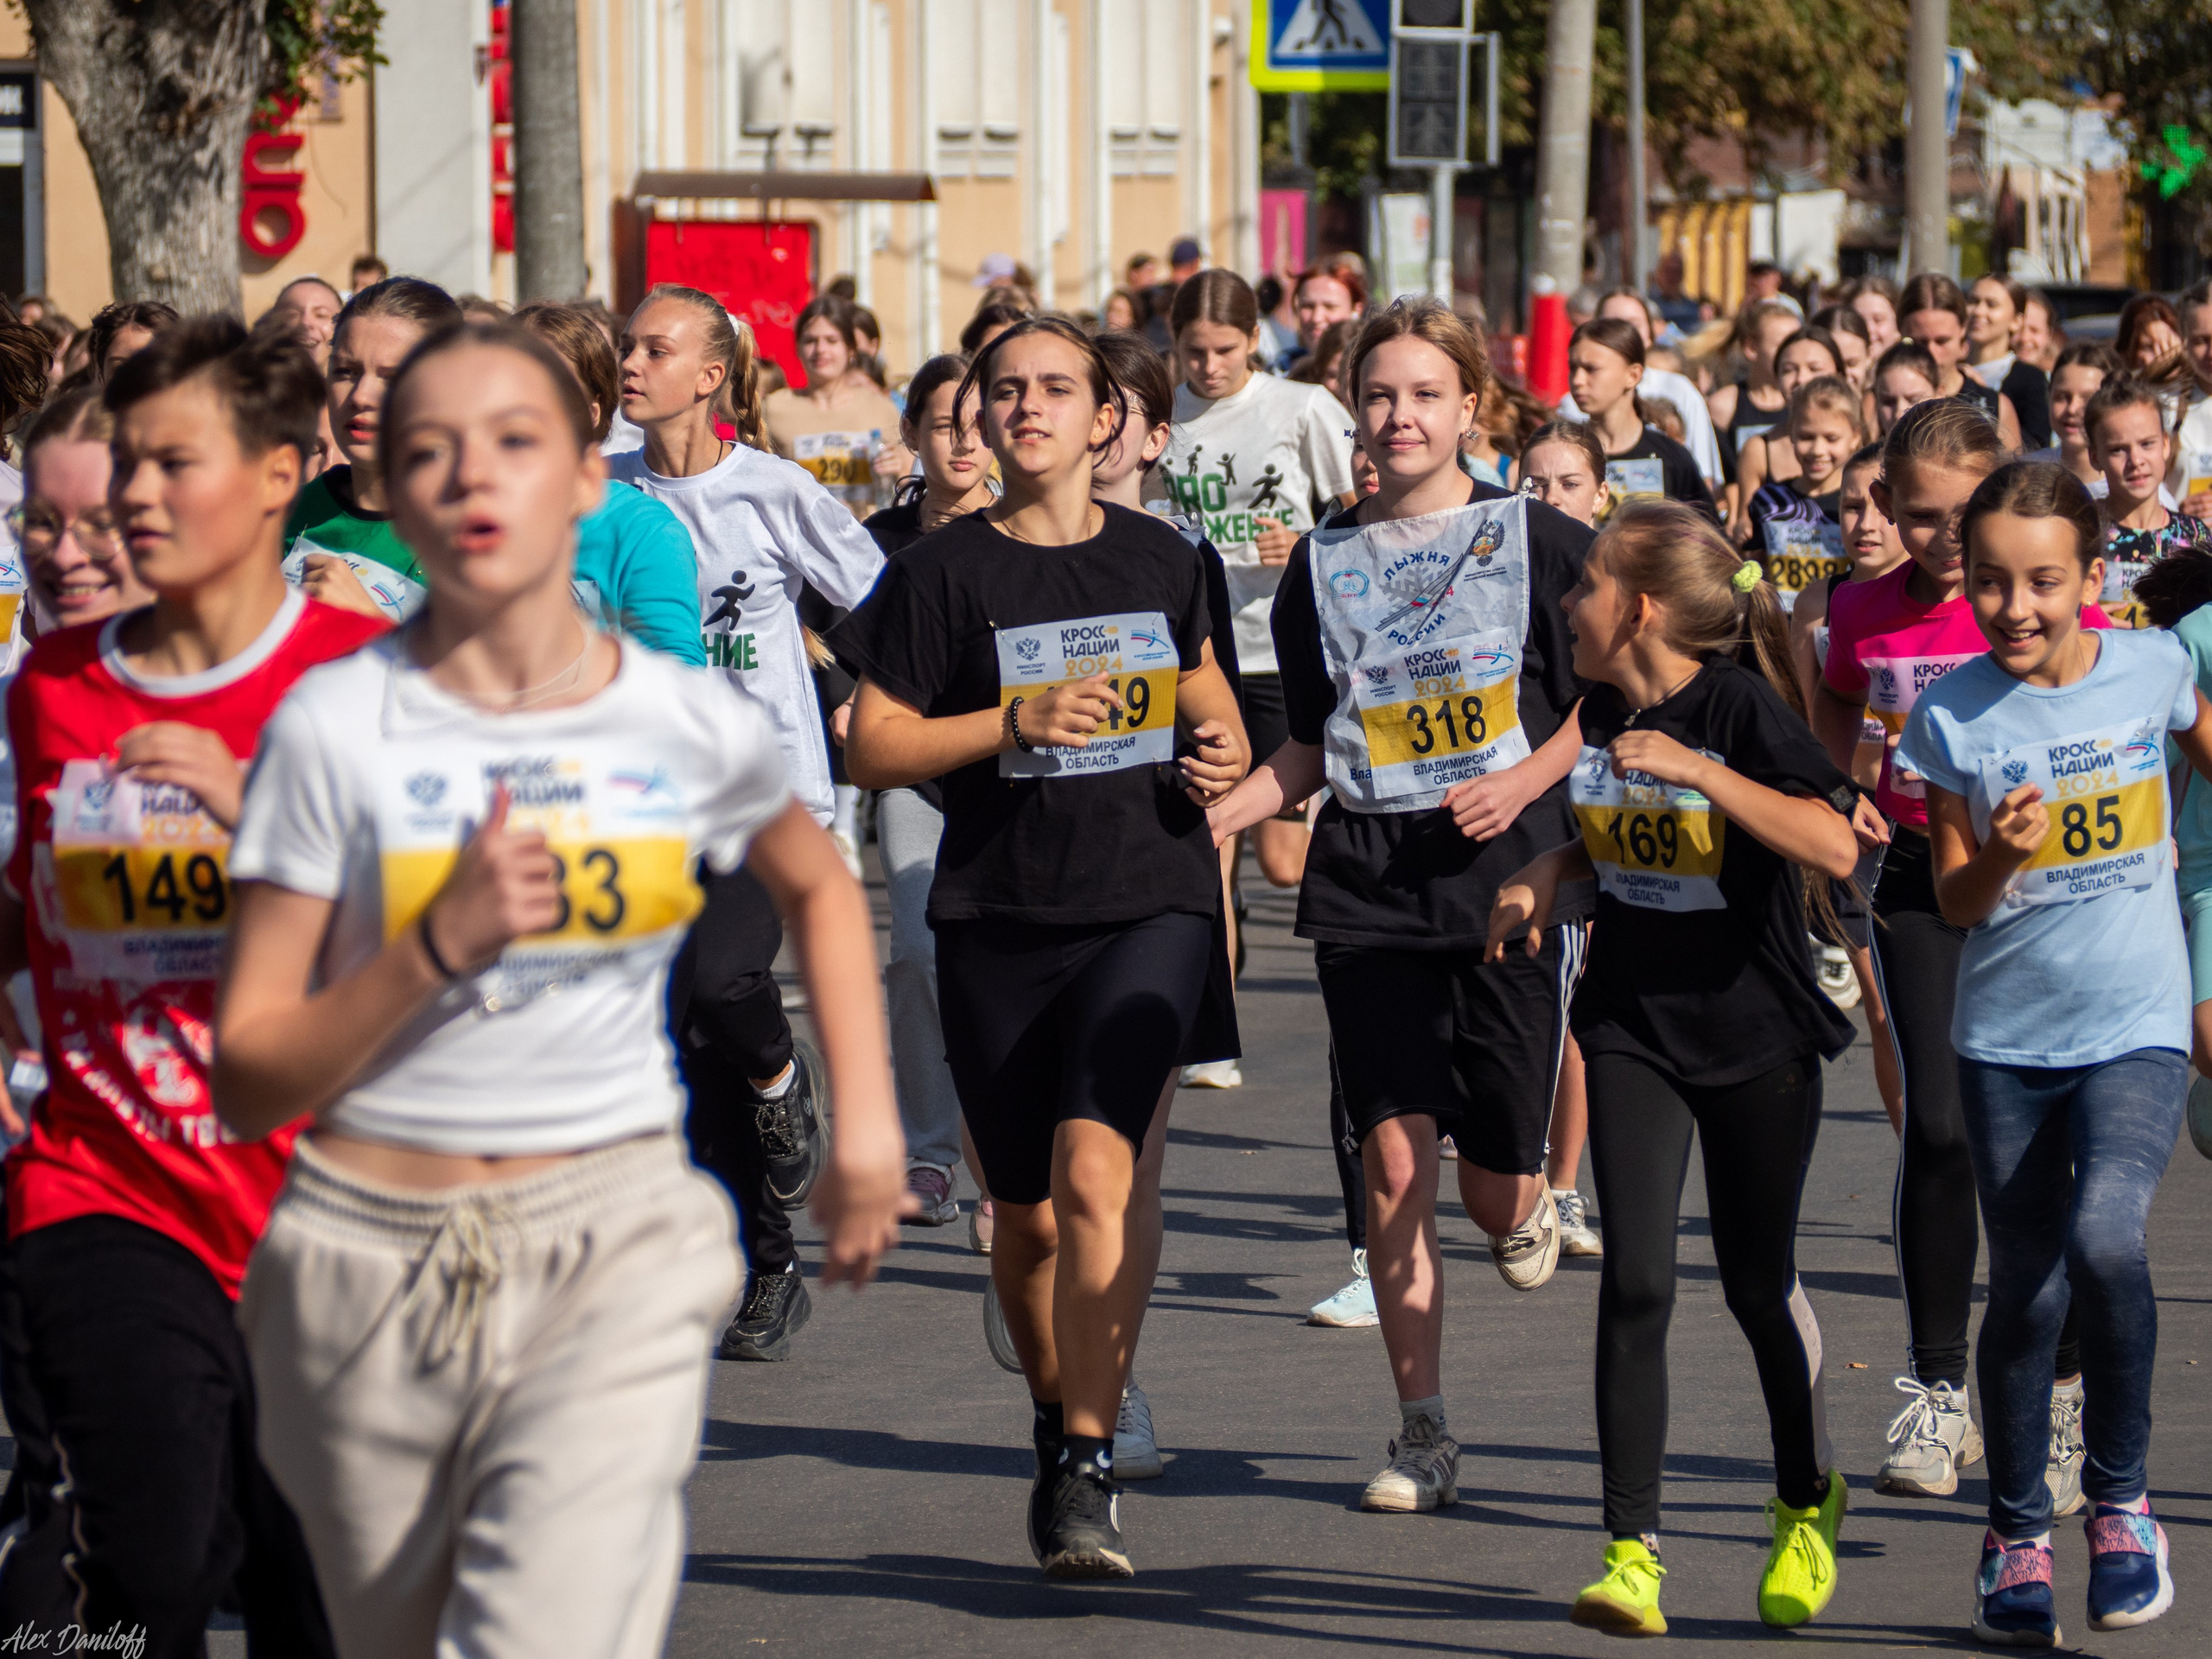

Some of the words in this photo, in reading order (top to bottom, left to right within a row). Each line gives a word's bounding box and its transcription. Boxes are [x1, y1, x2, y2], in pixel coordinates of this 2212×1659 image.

[1382, 550, 1451, 582] ЛЫЖНЯ
[1060, 625, 1106, 643] КРОСС
[1063, 639, 1121, 658] НАЦИИ
[1403, 647, 1447, 668] КРОСС
[1065, 654, 1124, 677] 2024
[1408, 659, 1462, 681] НАЦИИ
[1414, 673, 1467, 697] 2024
[1406, 695, 1486, 754] 318
[1065, 753, 1120, 770] ОБЛАСТЬ
[1413, 746, 1498, 776] ВЛАДИМИРСКАЯ
[2048, 739, 2099, 763] КРОСС
[1433, 766, 1487, 785] ОБЛАСТЬ
[2050, 752, 2114, 779] НАЦИИ
[2056, 769, 2120, 798] 2024
[2062, 794, 2124, 858] 85
[1607, 812, 1678, 869] 169
[2046, 852, 2145, 884] ВЛАДИМИРСКАЯ
[103, 851, 226, 924] 149
[2069, 873, 2126, 894] ОБЛАСТЬ
[1627, 887, 1665, 906] ОБЛАСТЬ
